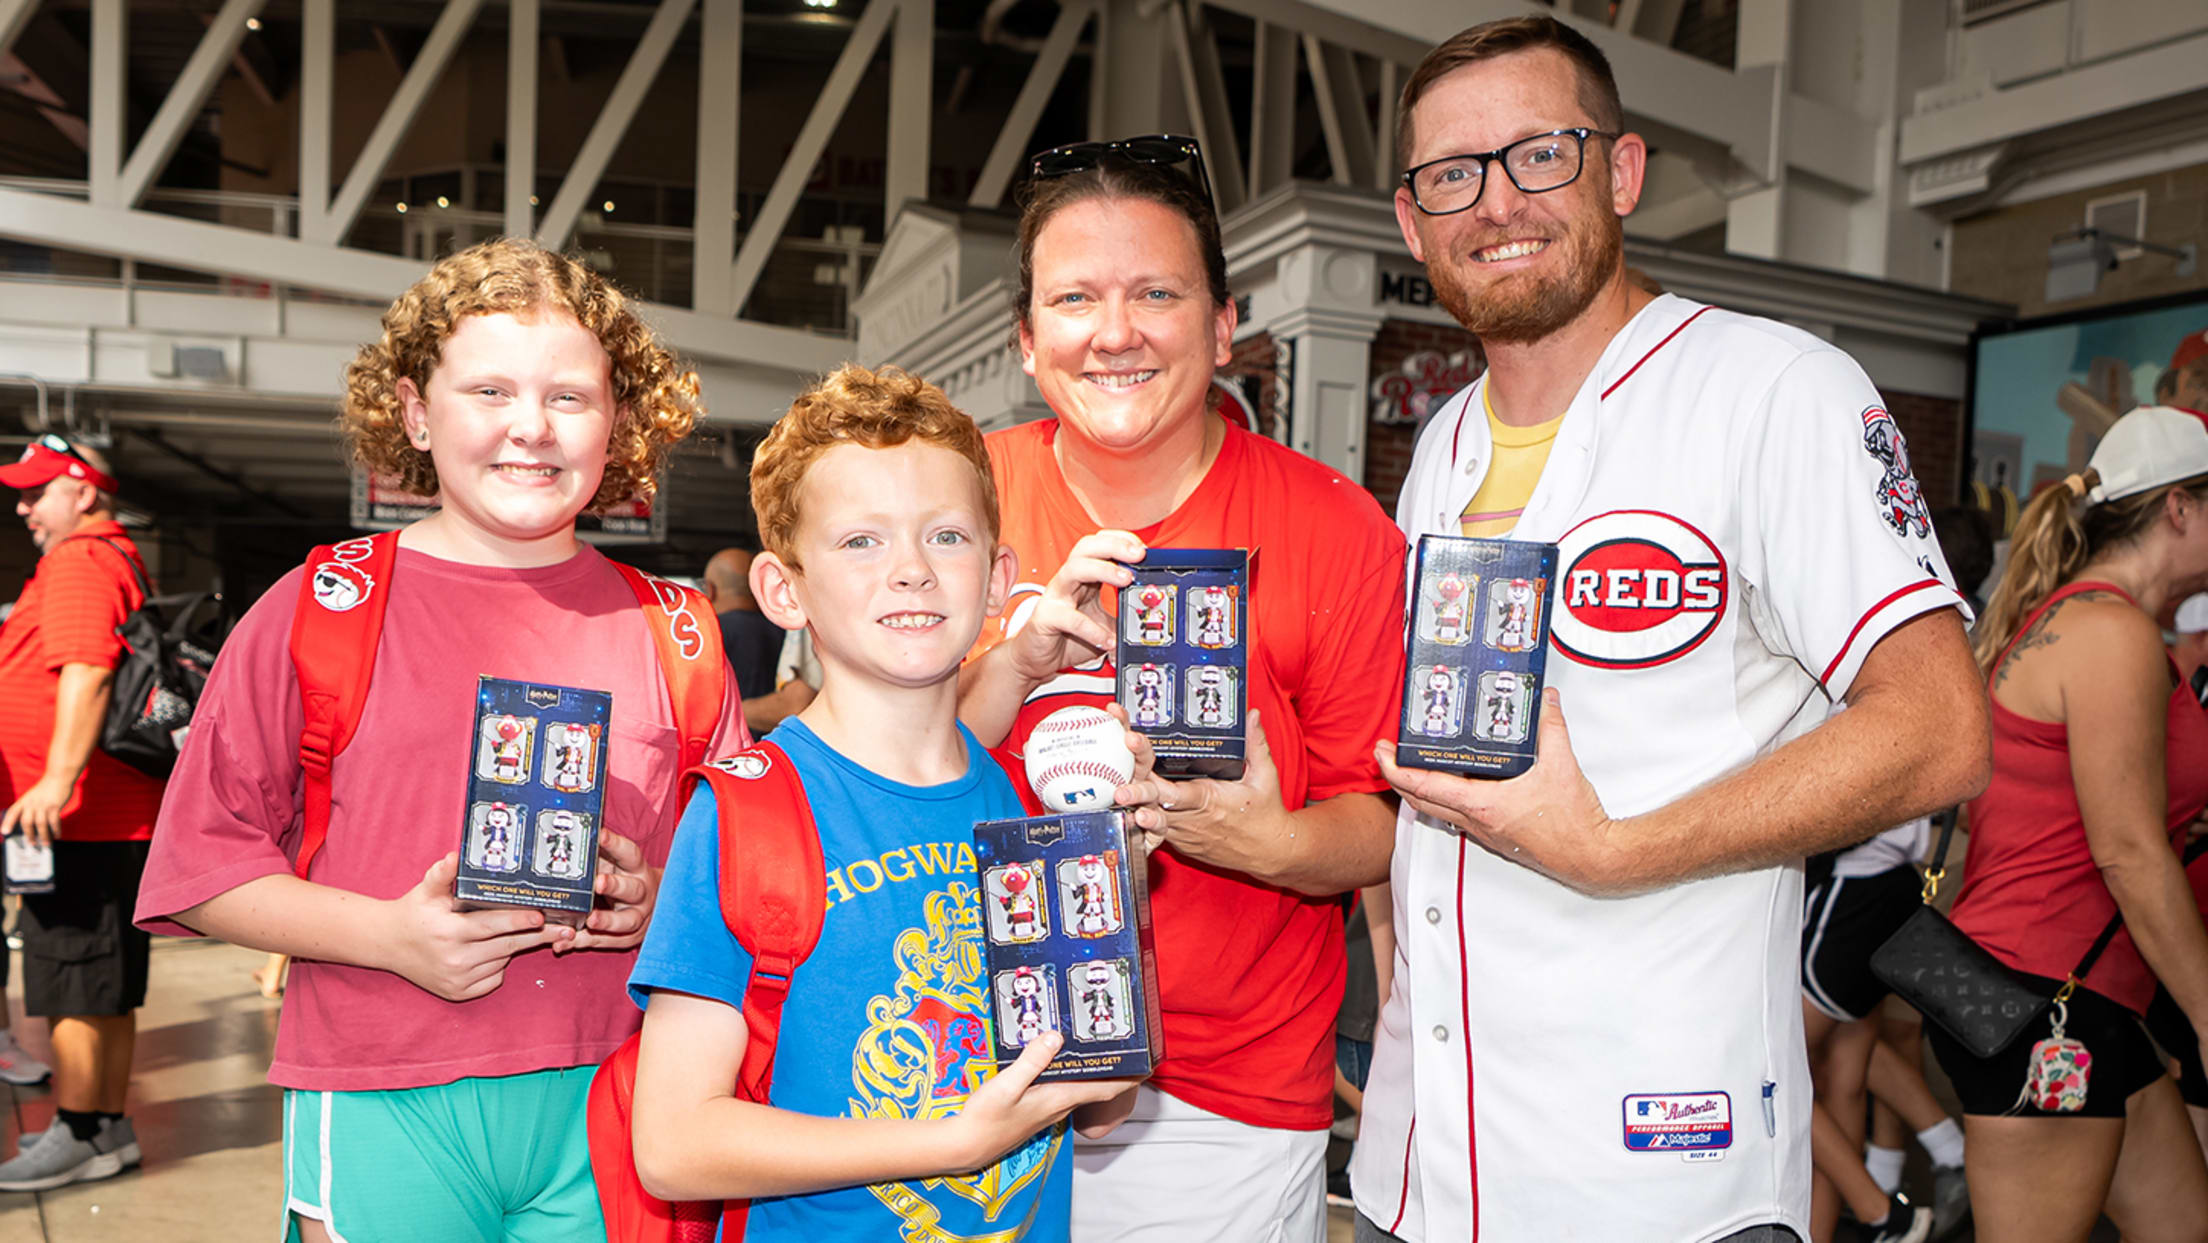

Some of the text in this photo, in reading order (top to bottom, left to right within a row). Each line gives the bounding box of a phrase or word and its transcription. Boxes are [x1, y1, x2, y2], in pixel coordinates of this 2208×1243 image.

[1570, 568, 1723, 609] REDS
[1418, 749, 1443, 758] WHICH
[1443, 751, 1458, 760] ONE
[1460, 753, 1475, 762] WILL
[1476, 755, 1492, 763] YOU
[477, 883, 502, 892] WHICH
[503, 886, 519, 894] ONE
[520, 888, 535, 896] WILL
[536, 889, 551, 898] YOU
[1065, 1058, 1083, 1068] WILL
[1083, 1057, 1101, 1067] YOU
[1101, 1056, 1122, 1065] GET?
[1664, 1099, 1717, 1121] Authentic
[1632, 1125, 1690, 1133] PERFORMANCE
[1669, 1133, 1711, 1146] Majestic
[879, 1183, 920, 1214] RACO
